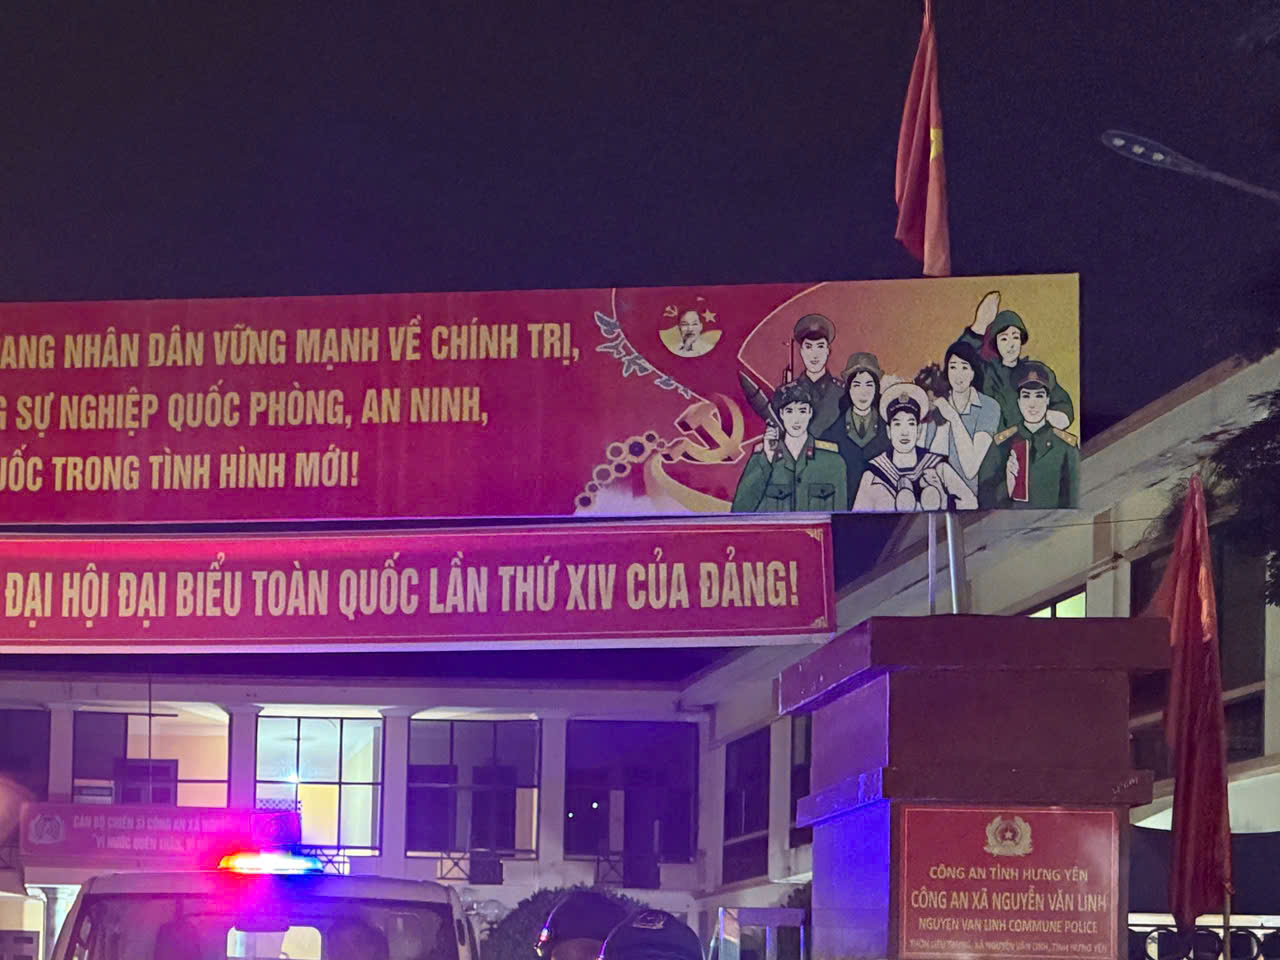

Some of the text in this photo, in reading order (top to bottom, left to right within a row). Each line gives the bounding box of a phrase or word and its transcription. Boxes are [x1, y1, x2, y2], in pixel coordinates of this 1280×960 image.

[63, 326, 139, 369] NHÂN
[147, 325, 205, 367] DÂN
[212, 322, 287, 366] VỮNG
[295, 327, 380, 371] MẠNH
[388, 314, 422, 362] VỀ
[431, 317, 519, 361] CHÍNH
[527, 322, 580, 366] TRỊ,
[16, 392, 55, 438] SỰ
[59, 386, 158, 436] NGHIỆP
[167, 379, 241, 433] QUỐC
[249, 381, 353, 429] PHÒNG,
[361, 387, 401, 425] AN
[409, 386, 489, 427] NINH,
[51, 455, 141, 492] TRONG
[148, 446, 211, 490] TÌNH
[218, 445, 286, 489] HÌNH
[294, 443, 360, 488] MỚI!
[4, 571, 53, 628] ĐẠI
[61, 562, 110, 627] HỘI
[117, 571, 167, 627] ĐẠI
[175, 551, 243, 617] BIỂU
[251, 559, 329, 617] TOÀN
[338, 551, 419, 621] QUỐC
[428, 550, 489, 614] LẦN
[498, 554, 560, 613] THỨ
[565, 563, 617, 611] XIV
[626, 546, 690, 610] CỦA
[699, 545, 799, 608] ĐẢNG!
[929, 863, 965, 880] CÔNG
[968, 866, 987, 880] AN
[1022, 866, 1061, 882] HƯNG
[1064, 865, 1088, 882] YÊN
[911, 885, 1107, 913] CÔNG AN XÃ NGUYỄN VĂN LINH
[918, 917, 959, 931] NGUYEN
[984, 918, 1007, 932] LINH
[1008, 918, 1063, 933] COMMUNE
[1064, 920, 1098, 934] POLICE
